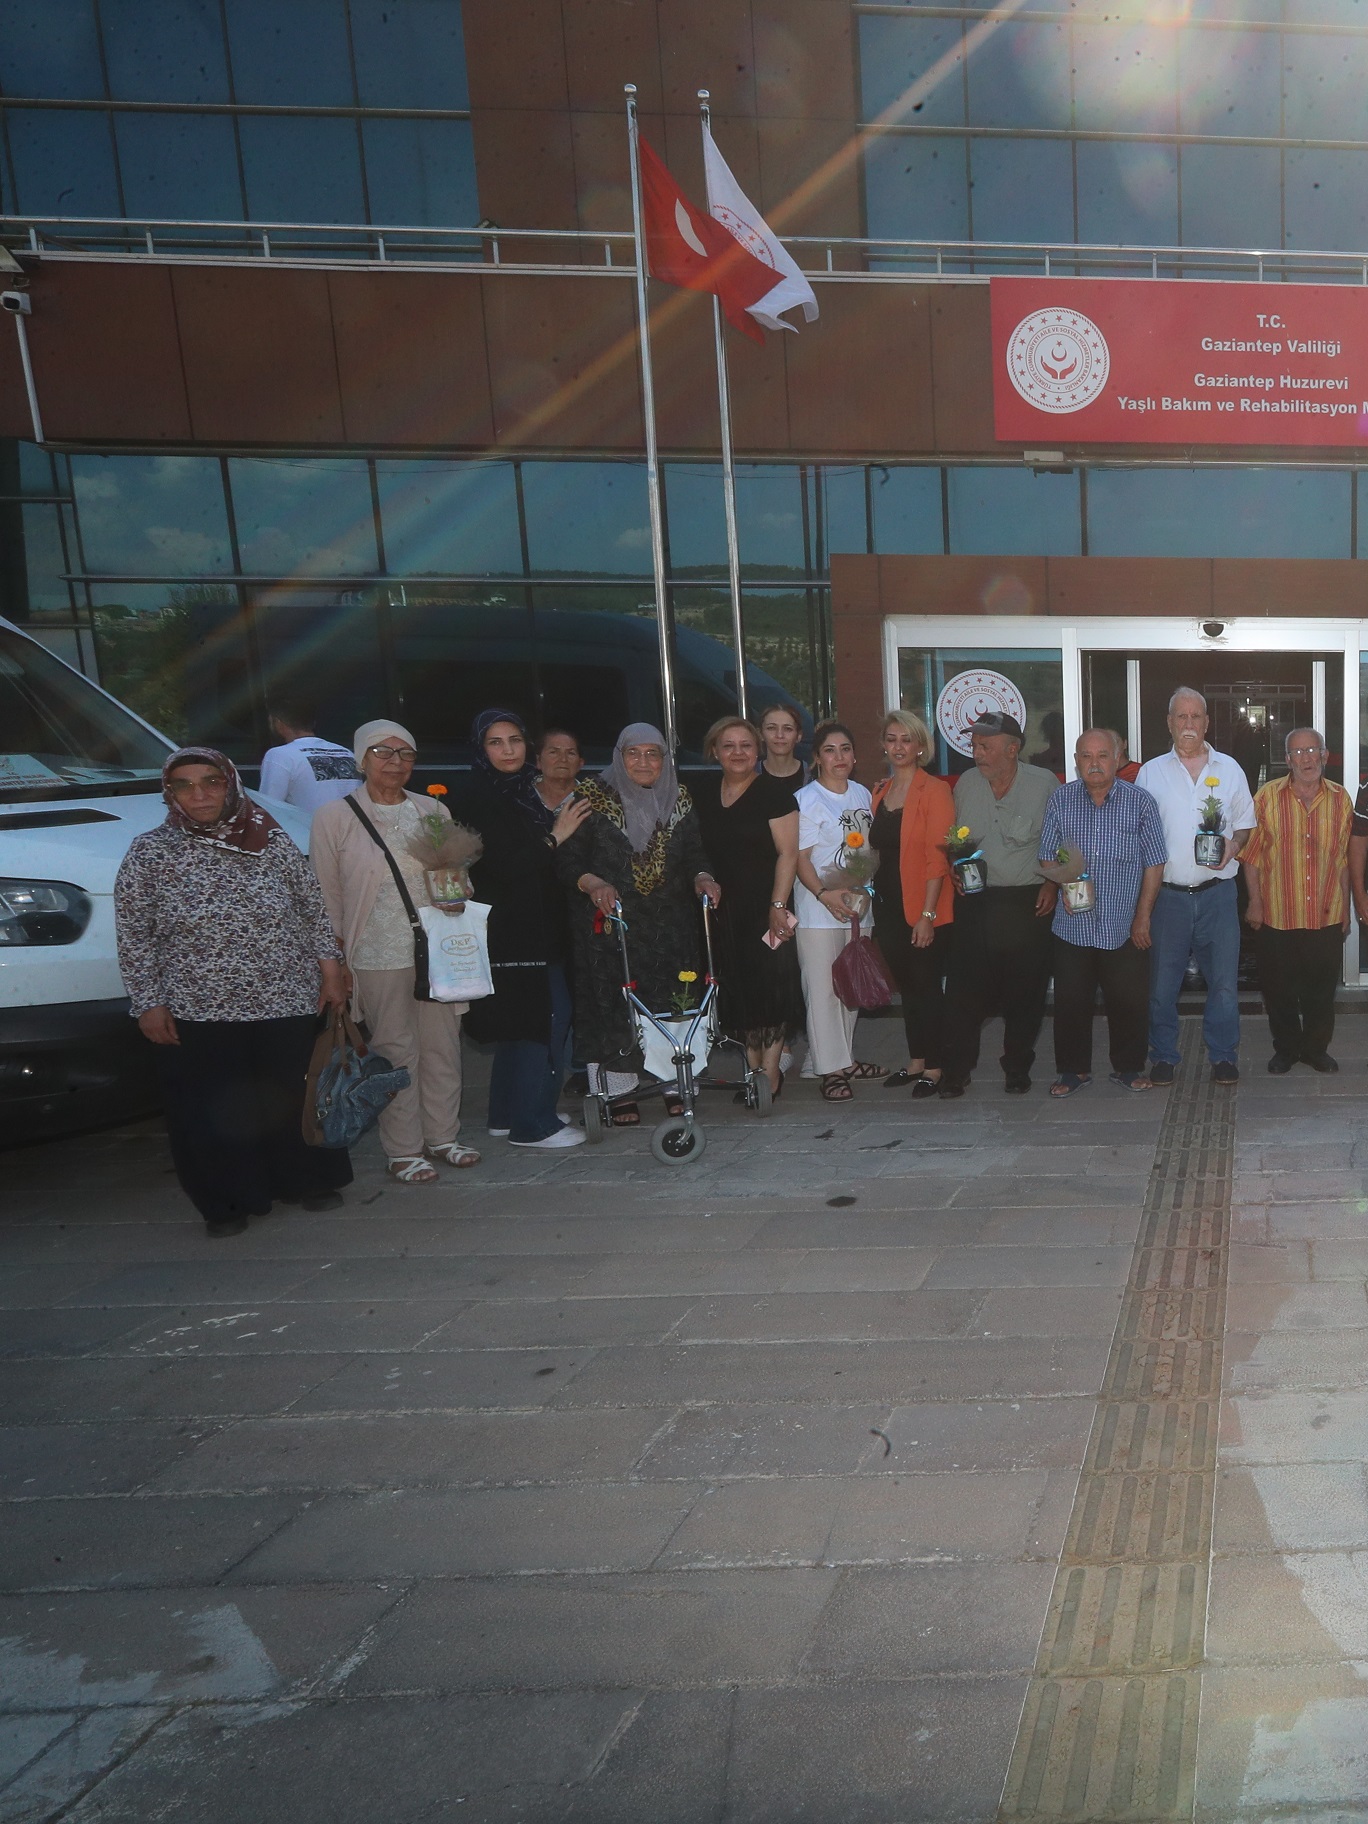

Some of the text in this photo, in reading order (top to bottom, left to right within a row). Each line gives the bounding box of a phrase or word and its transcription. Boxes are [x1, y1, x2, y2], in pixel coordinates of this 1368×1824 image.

[1256, 314, 1286, 328] T.C.
[1060, 327, 1079, 340] SOSYAL
[1201, 337, 1341, 357] Gaziantep Valiliği
[1194, 373, 1349, 391] Gaziantep Huzurevi
[1117, 396, 1156, 413] Yaşlı
[1161, 397, 1212, 411] Bakım
[1216, 401, 1235, 412] ve
[1240, 398, 1358, 417] Rehabilitasyon
